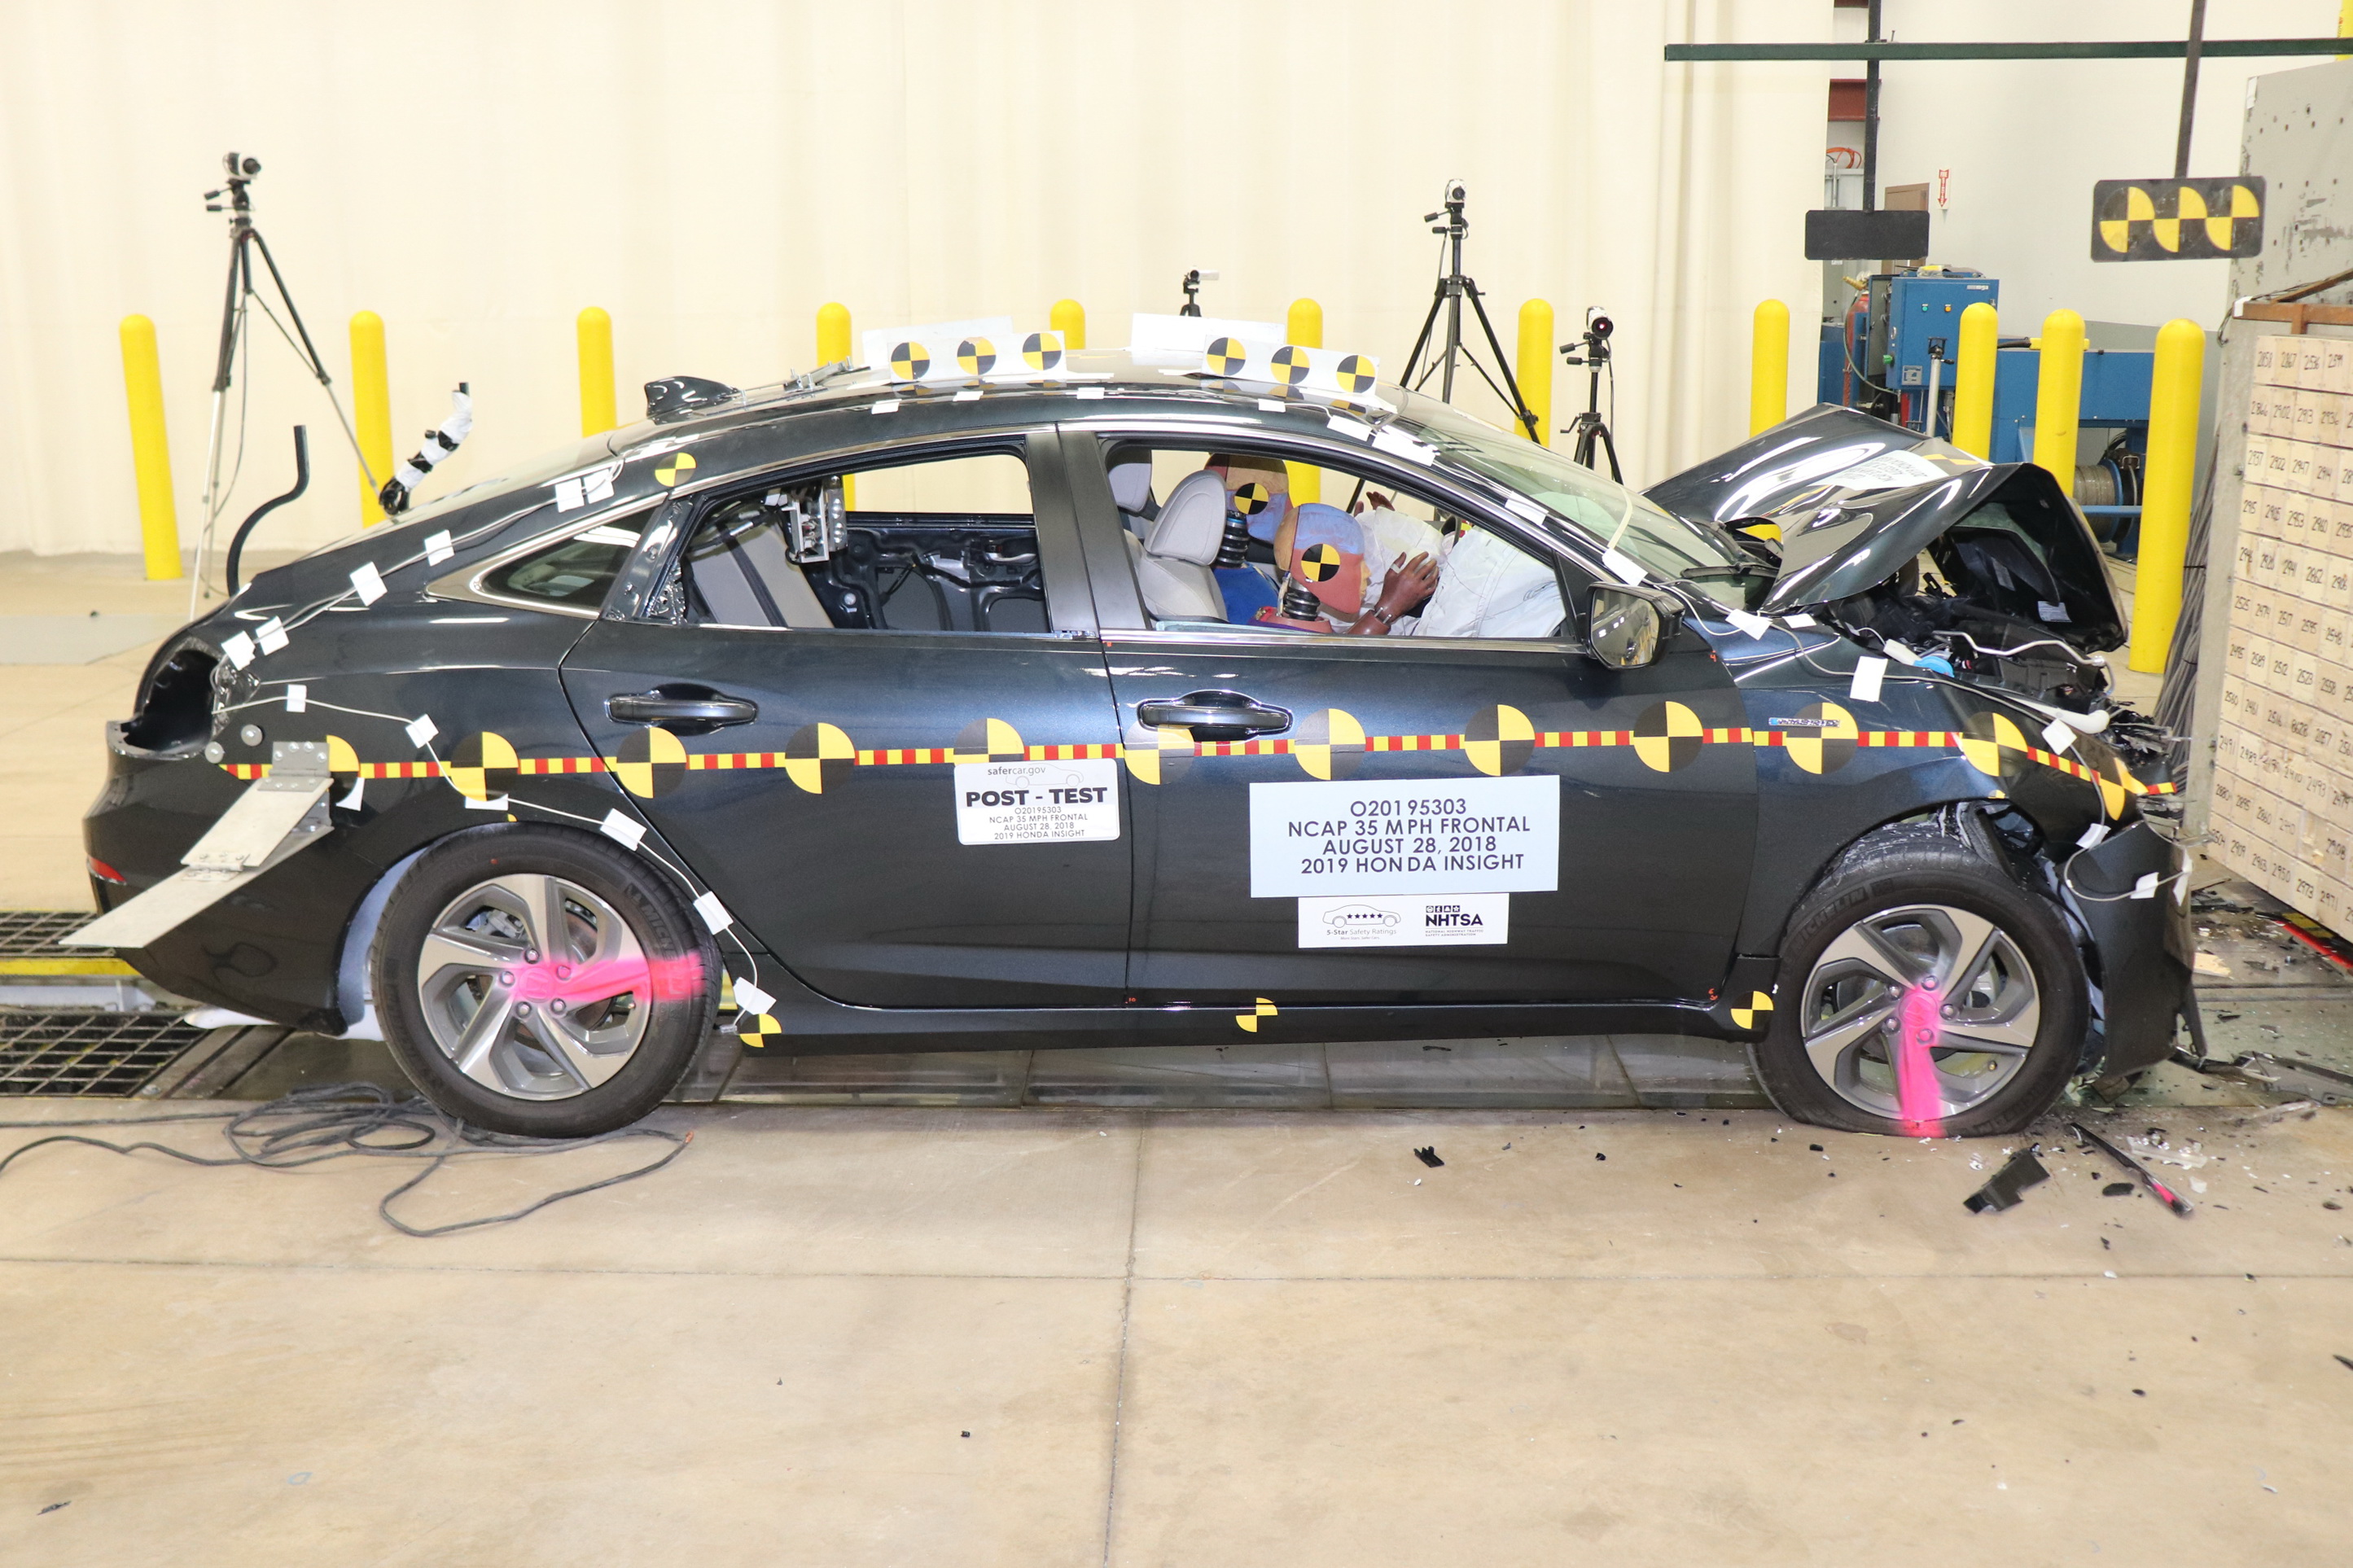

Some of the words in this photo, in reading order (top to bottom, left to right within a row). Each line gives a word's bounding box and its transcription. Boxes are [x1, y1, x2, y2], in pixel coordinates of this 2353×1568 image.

[2296, 668, 2314, 685] 2523
[988, 765, 1046, 777] safercar.gov
[966, 790, 1029, 807] POST
[1049, 787, 1107, 804] TEST
[989, 816, 1014, 824] NCAP
[1016, 815, 1027, 823] 35
[1029, 814, 1048, 822] MPH
[1050, 813, 1088, 821] FRONTAL
[1004, 823, 1037, 831] AUGUST
[1054, 821, 1075, 830] 2018
[1288, 820, 1347, 838] NCAP
[1354, 819, 1378, 836] 35
[1385, 817, 1432, 835] MPH
[1440, 815, 1531, 834] FRONTAL
[994, 832, 1014, 840] 2019
[1016, 830, 1049, 839] HONDA
[1051, 830, 1085, 839] INSIGHT
[1322, 838, 1404, 856] AUGUST
[1413, 837, 1441, 856] 28,
[1448, 835, 1496, 852] 2018
[1300, 857, 1348, 875] 2019
[1356, 855, 1437, 874] HONDA
[1444, 853, 1525, 872] INSIGHT
[1426, 913, 1483, 926] NHTSA
